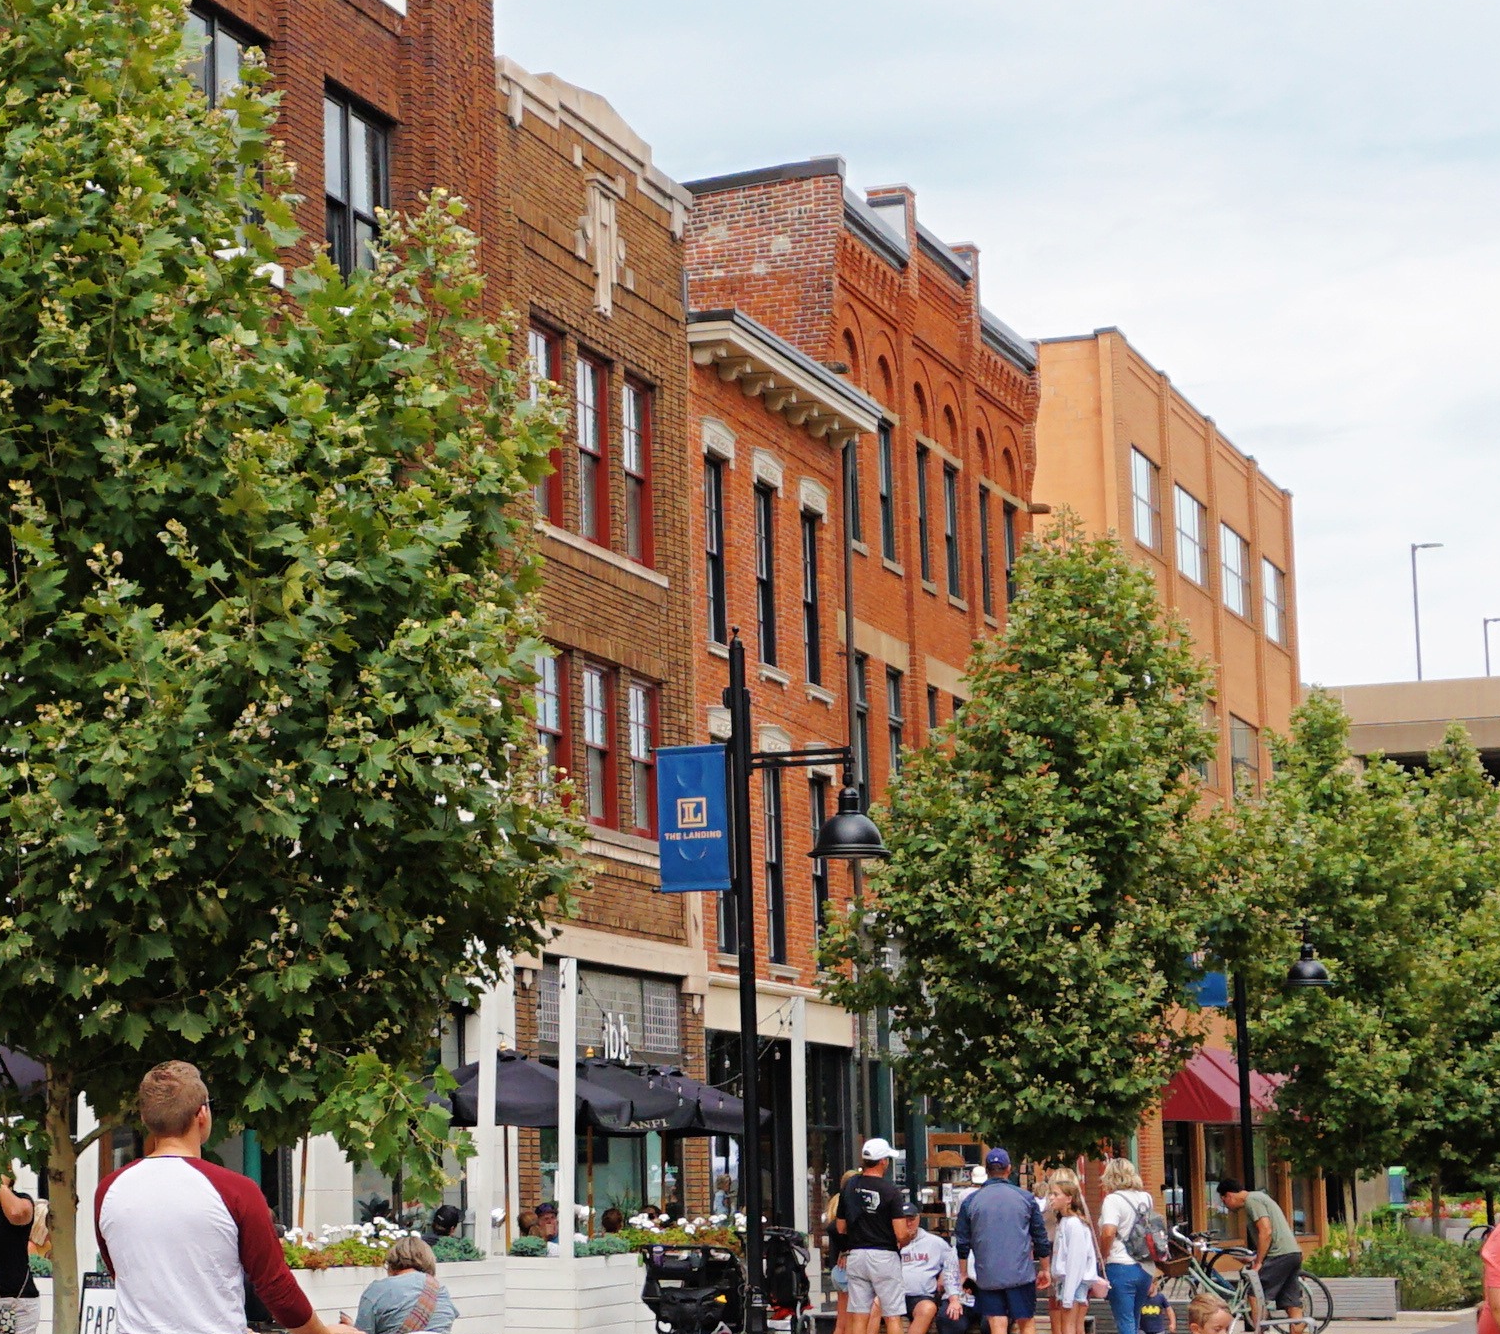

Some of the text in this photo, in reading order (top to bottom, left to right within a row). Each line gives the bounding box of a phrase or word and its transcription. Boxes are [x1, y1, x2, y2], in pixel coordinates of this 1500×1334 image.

[664, 830, 722, 841] THE LANDING
[621, 1117, 670, 1130] ANFI
